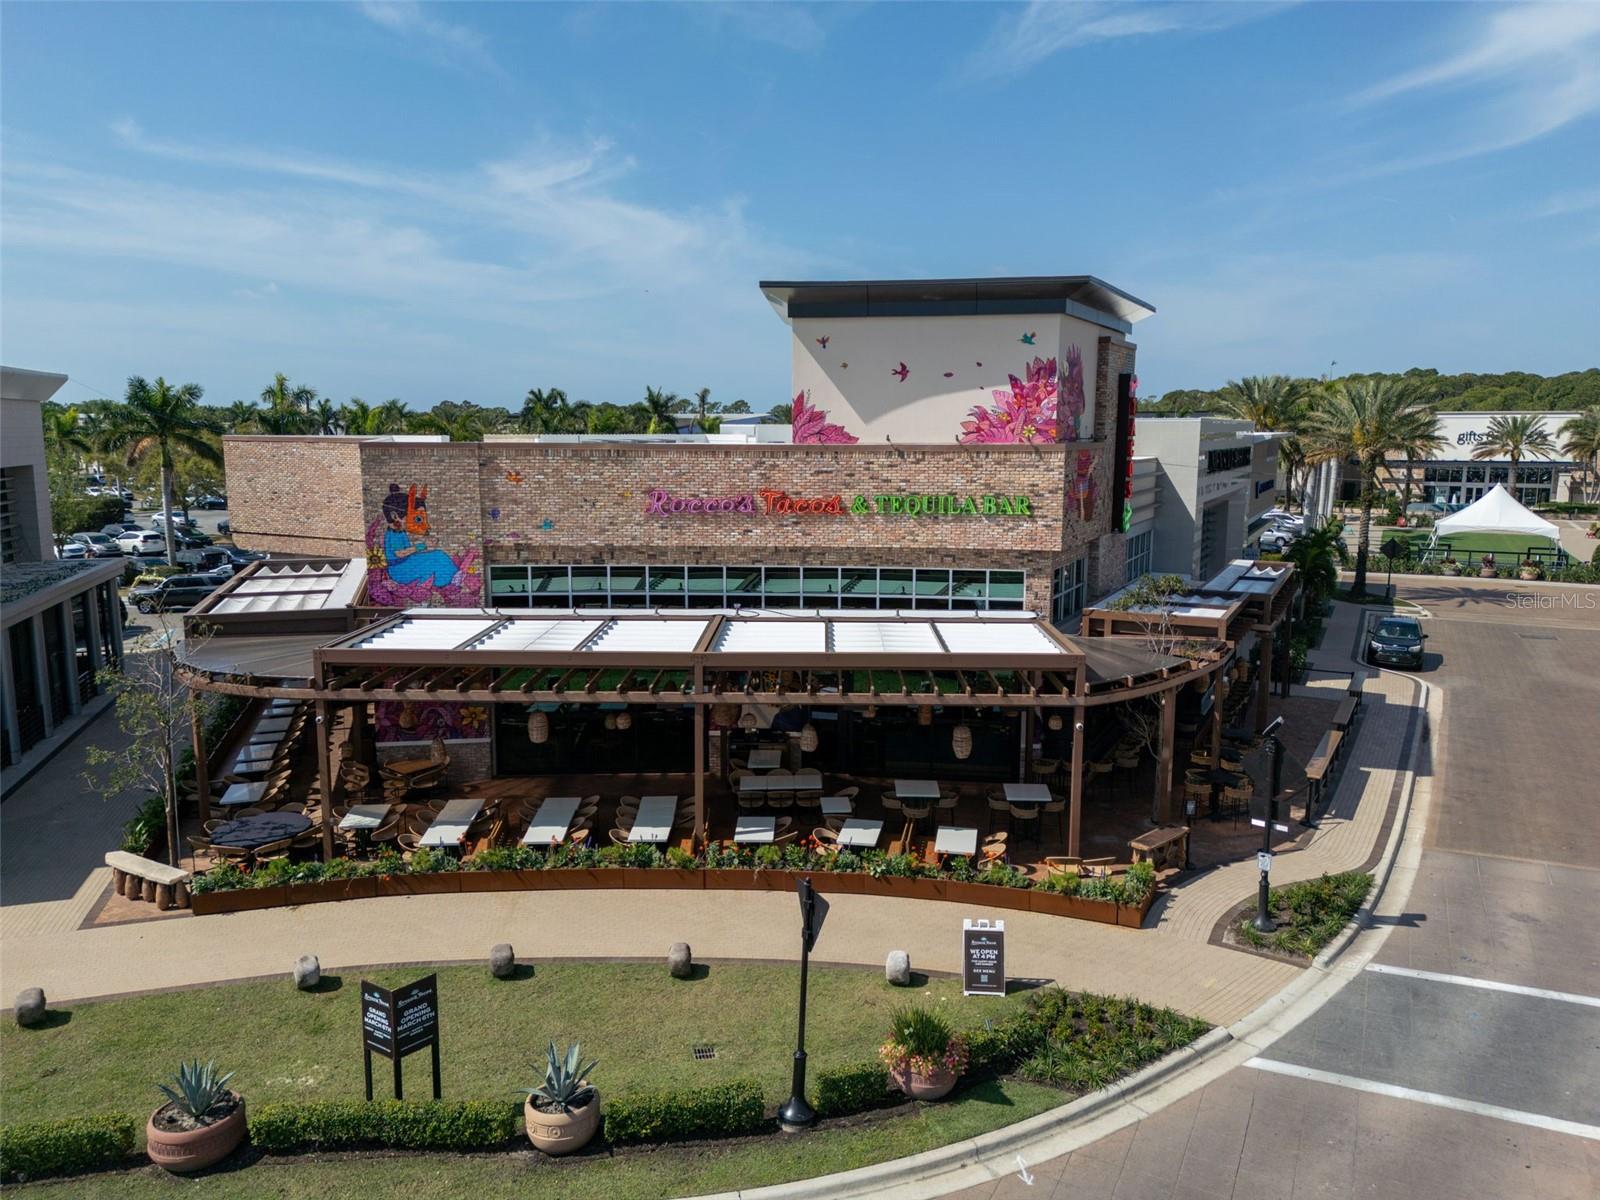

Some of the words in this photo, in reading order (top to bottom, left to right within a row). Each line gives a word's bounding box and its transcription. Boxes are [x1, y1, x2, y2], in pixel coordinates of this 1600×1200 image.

[1457, 430, 1483, 445] gifts
[647, 488, 755, 517] Rocco's
[759, 487, 844, 516] Tacos
[851, 495, 869, 515] &
[873, 495, 978, 518] TEQUILA
[980, 495, 1034, 516] BAR
[400, 1006, 431, 1024] OPENING
[403, 1002, 428, 1017] GRAND
[397, 1017, 422, 1032] MARCH
